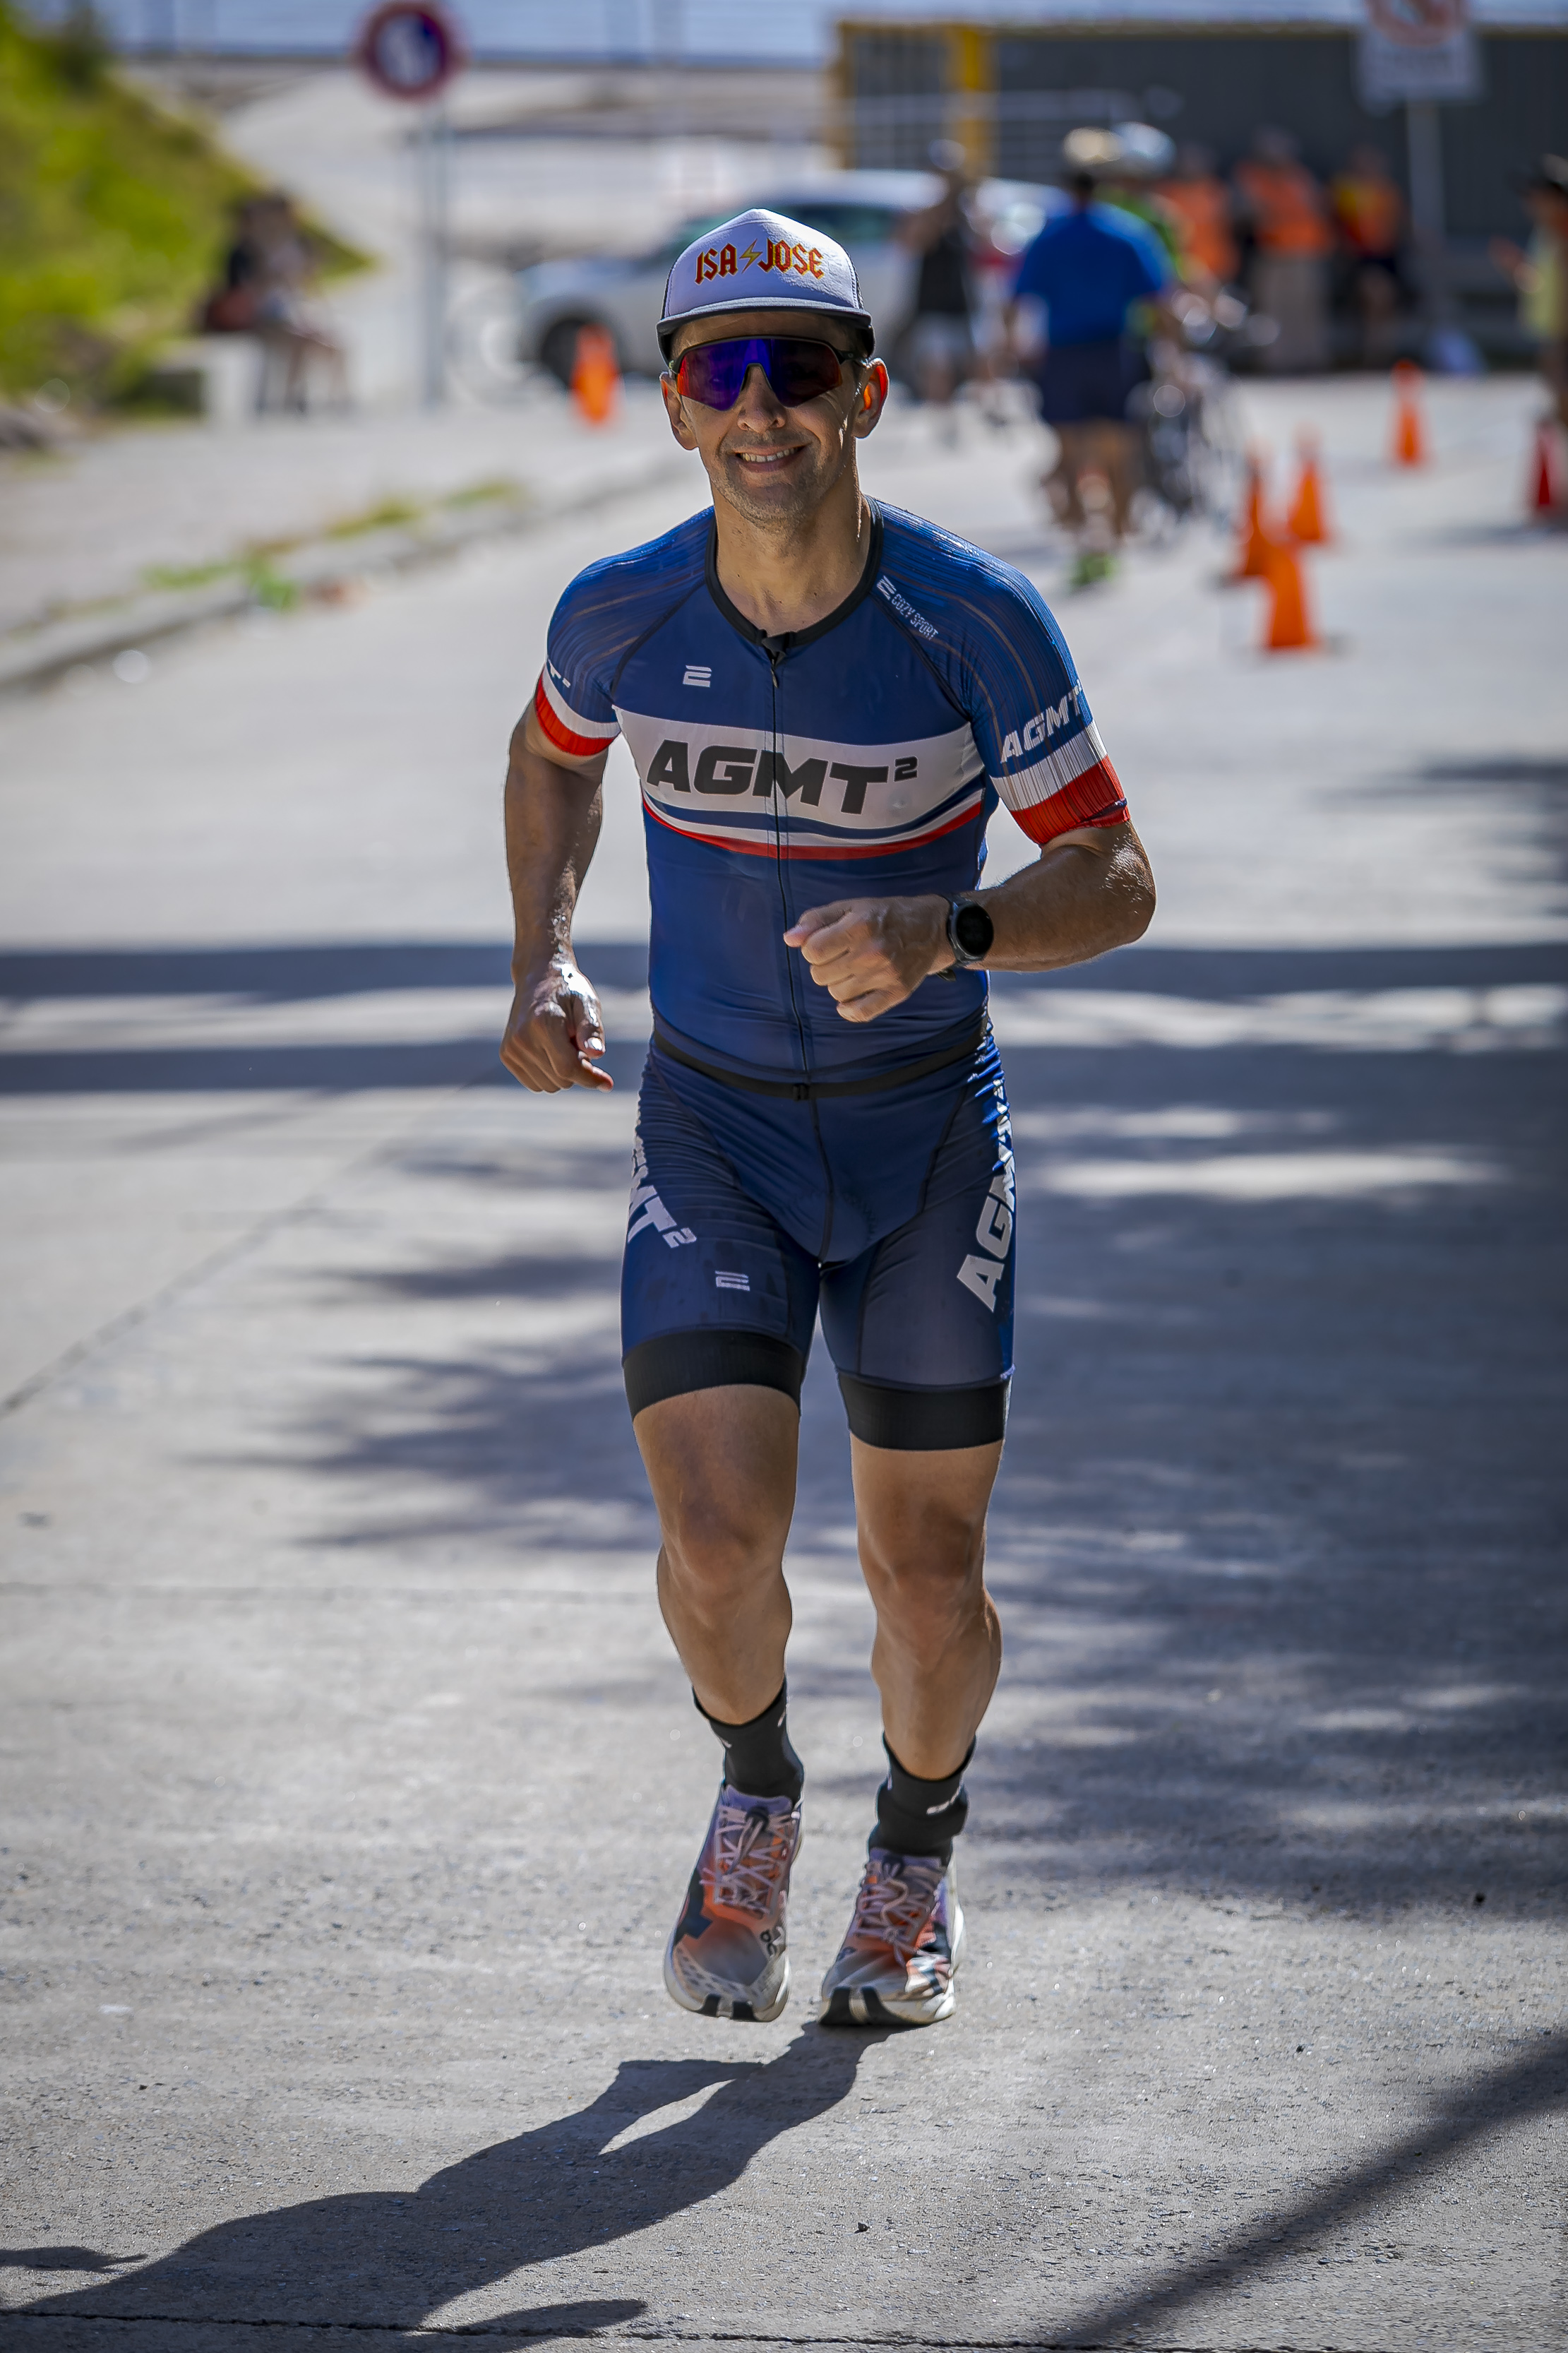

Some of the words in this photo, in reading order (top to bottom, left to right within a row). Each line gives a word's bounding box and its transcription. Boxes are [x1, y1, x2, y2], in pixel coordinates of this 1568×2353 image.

[695, 242, 738, 285] ISA
[758, 238, 825, 280] JOSE
[891, 593, 916, 619] COZY
[910, 612, 939, 641] SPORT
